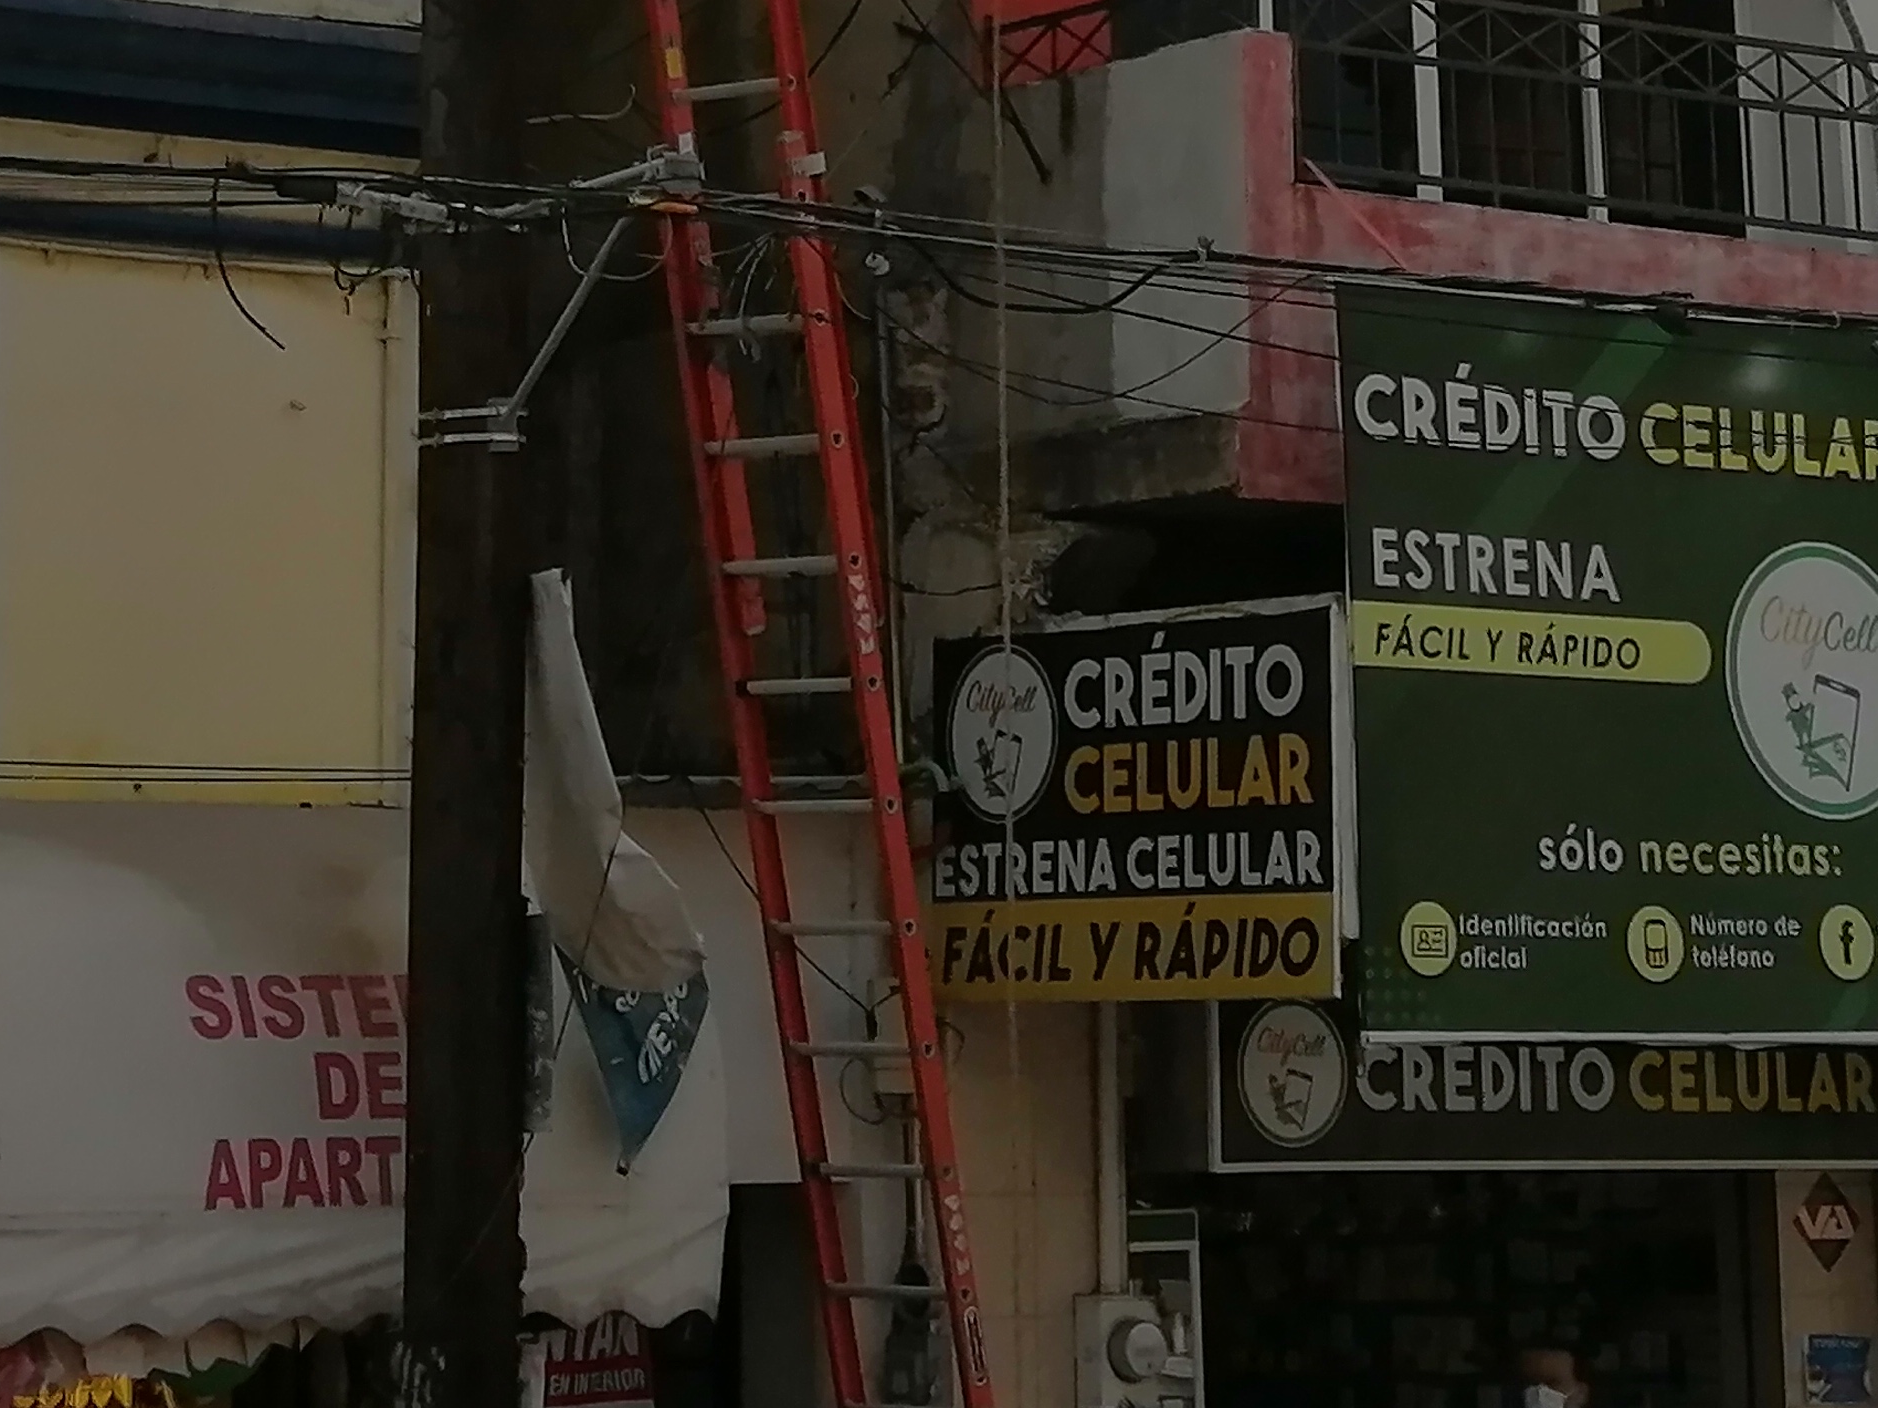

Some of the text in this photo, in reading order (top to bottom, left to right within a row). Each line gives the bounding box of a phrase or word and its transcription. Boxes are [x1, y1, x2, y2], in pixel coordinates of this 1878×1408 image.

[1353, 361, 1625, 462] CRÉDITO
[1371, 525, 1622, 604] ESTRENA
[1374, 614, 1641, 670] FÁCIL Y RÁPIDO
[1063, 630, 1304, 730] CRÉDITO
[1063, 733, 1314, 816] CELULAR
[934, 829, 1324, 899] ESTRENA CELULAR
[1537, 823, 1843, 878] sólo necesitas:
[941, 901, 1321, 985] FÁCIL Y RÁPIDO
[1458, 911, 1609, 939] Identificación
[1459, 943, 1529, 970] oficial
[1689, 910, 1802, 937] Número de
[188, 972, 406, 1042] SISTE
[312, 1051, 406, 1121] DE
[1629, 1050, 1876, 1114] CELULAR
[203, 1136, 404, 1210] APART
